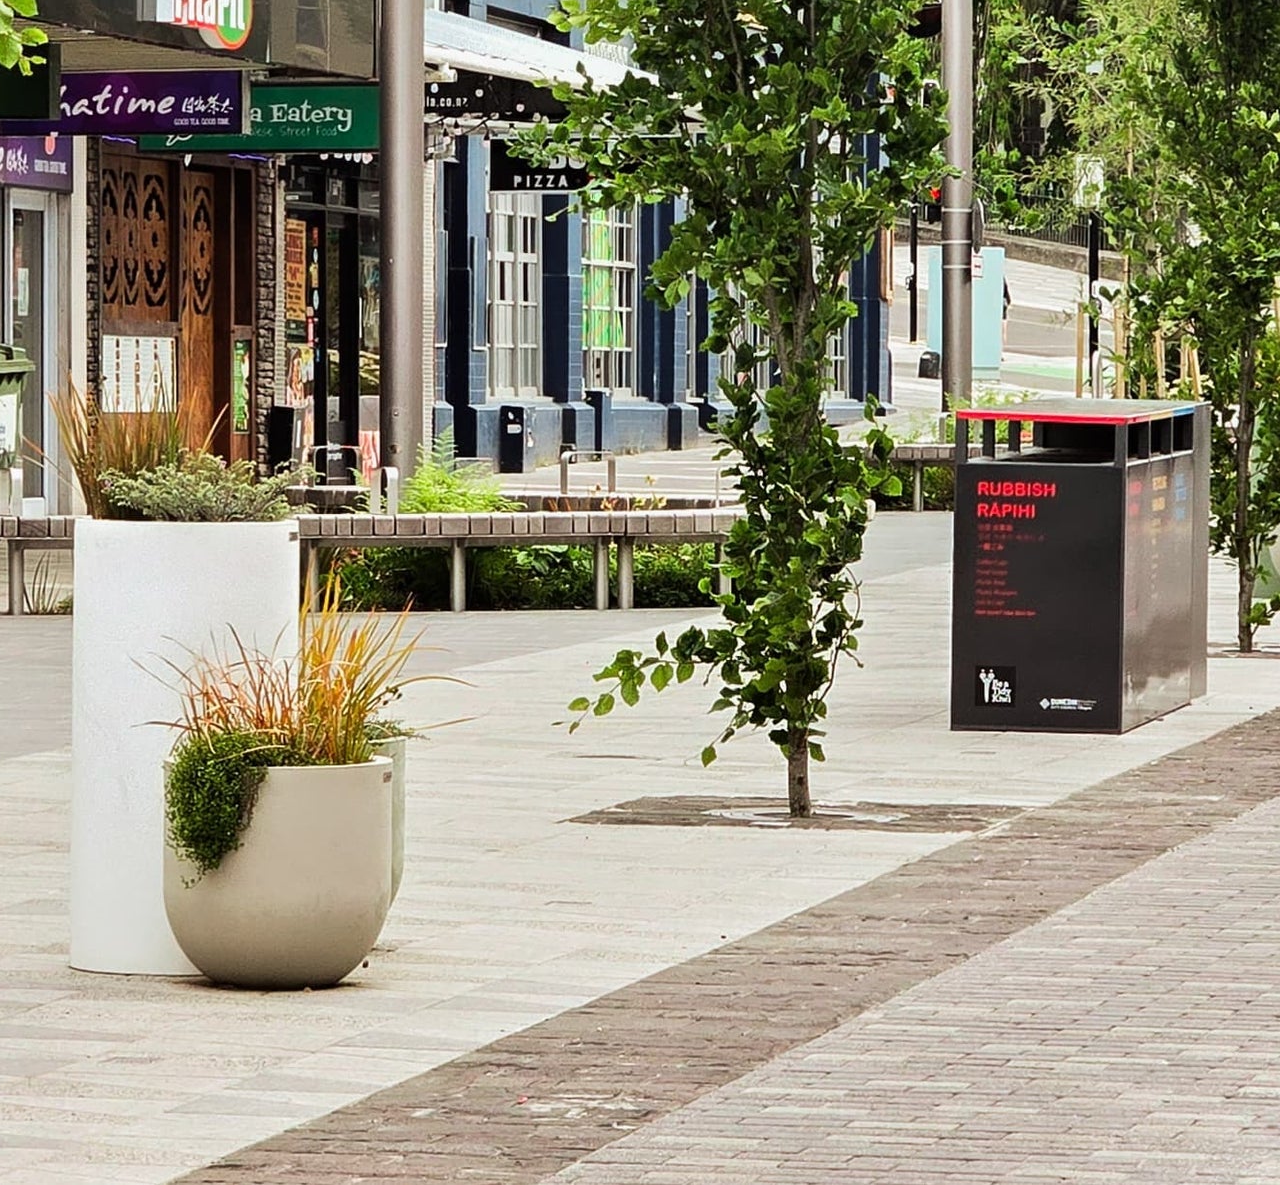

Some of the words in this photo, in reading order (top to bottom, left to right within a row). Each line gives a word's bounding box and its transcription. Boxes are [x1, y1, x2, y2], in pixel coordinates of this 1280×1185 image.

[60, 84, 176, 117] hatime
[250, 104, 262, 122] a
[269, 99, 353, 132] Eatery
[279, 125, 311, 137] Street
[316, 125, 338, 137] Food
[513, 174, 568, 188] PIZZA
[977, 481, 1057, 498] RUBBISH
